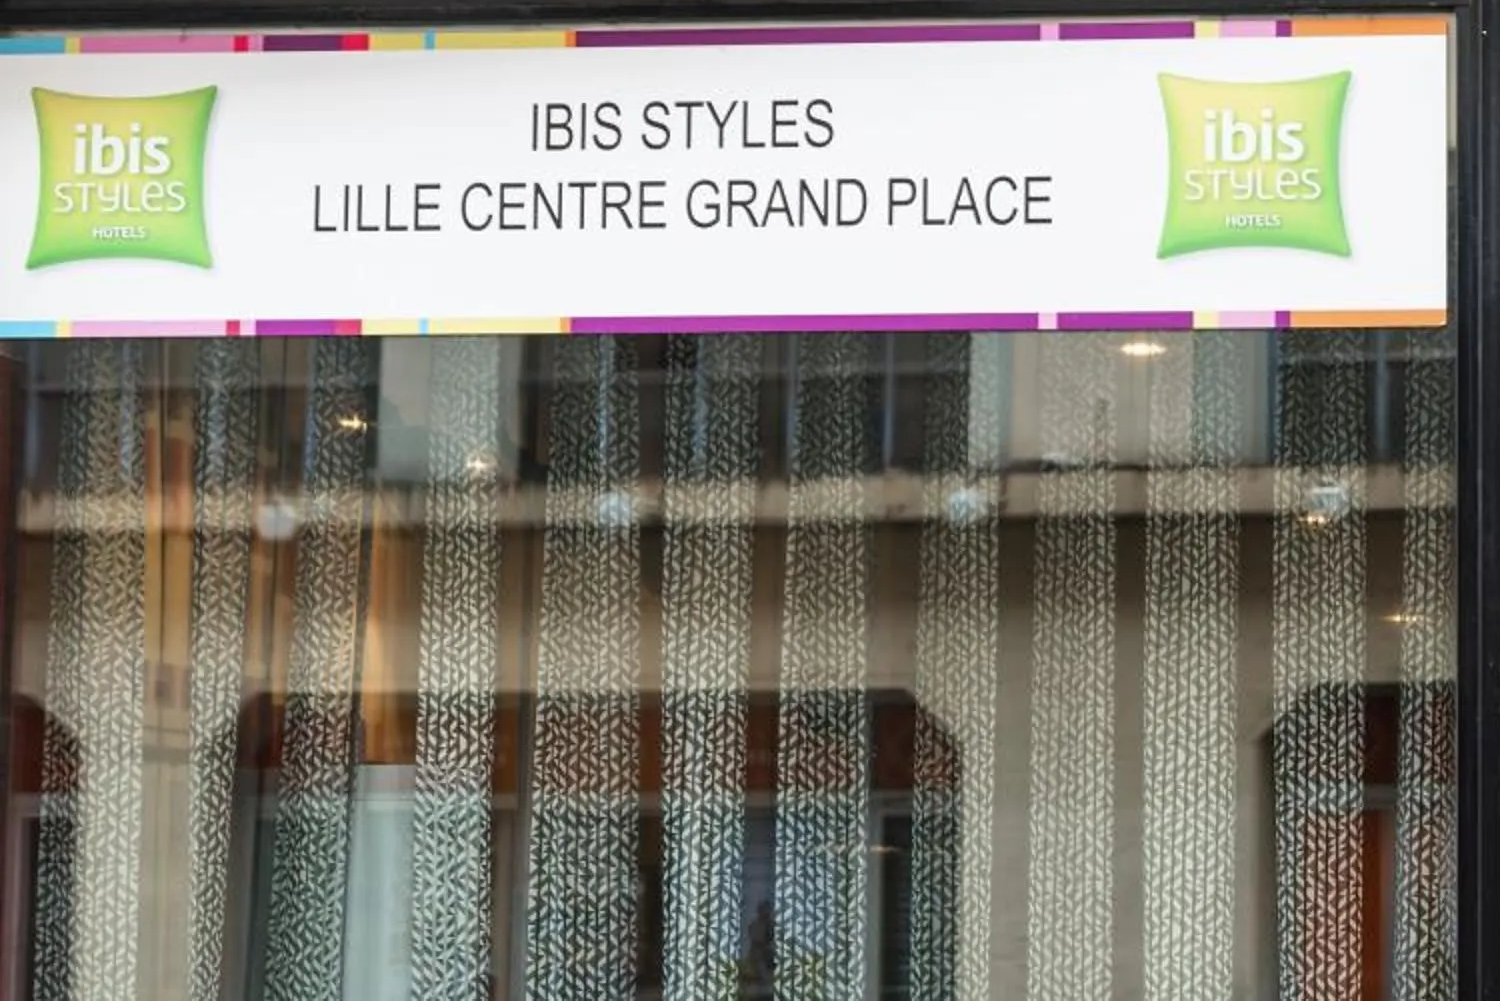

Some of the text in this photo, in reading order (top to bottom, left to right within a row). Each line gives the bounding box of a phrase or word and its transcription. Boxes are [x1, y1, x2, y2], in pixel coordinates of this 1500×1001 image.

[72, 120, 171, 176] ibis
[531, 98, 835, 152] IBIS STYLES
[1203, 108, 1305, 163] ibis
[313, 176, 1054, 233] LILLE CENTRE GRAND PLACE
[1224, 213, 1282, 229] HOTELS
[91, 225, 147, 240] HOTELS
